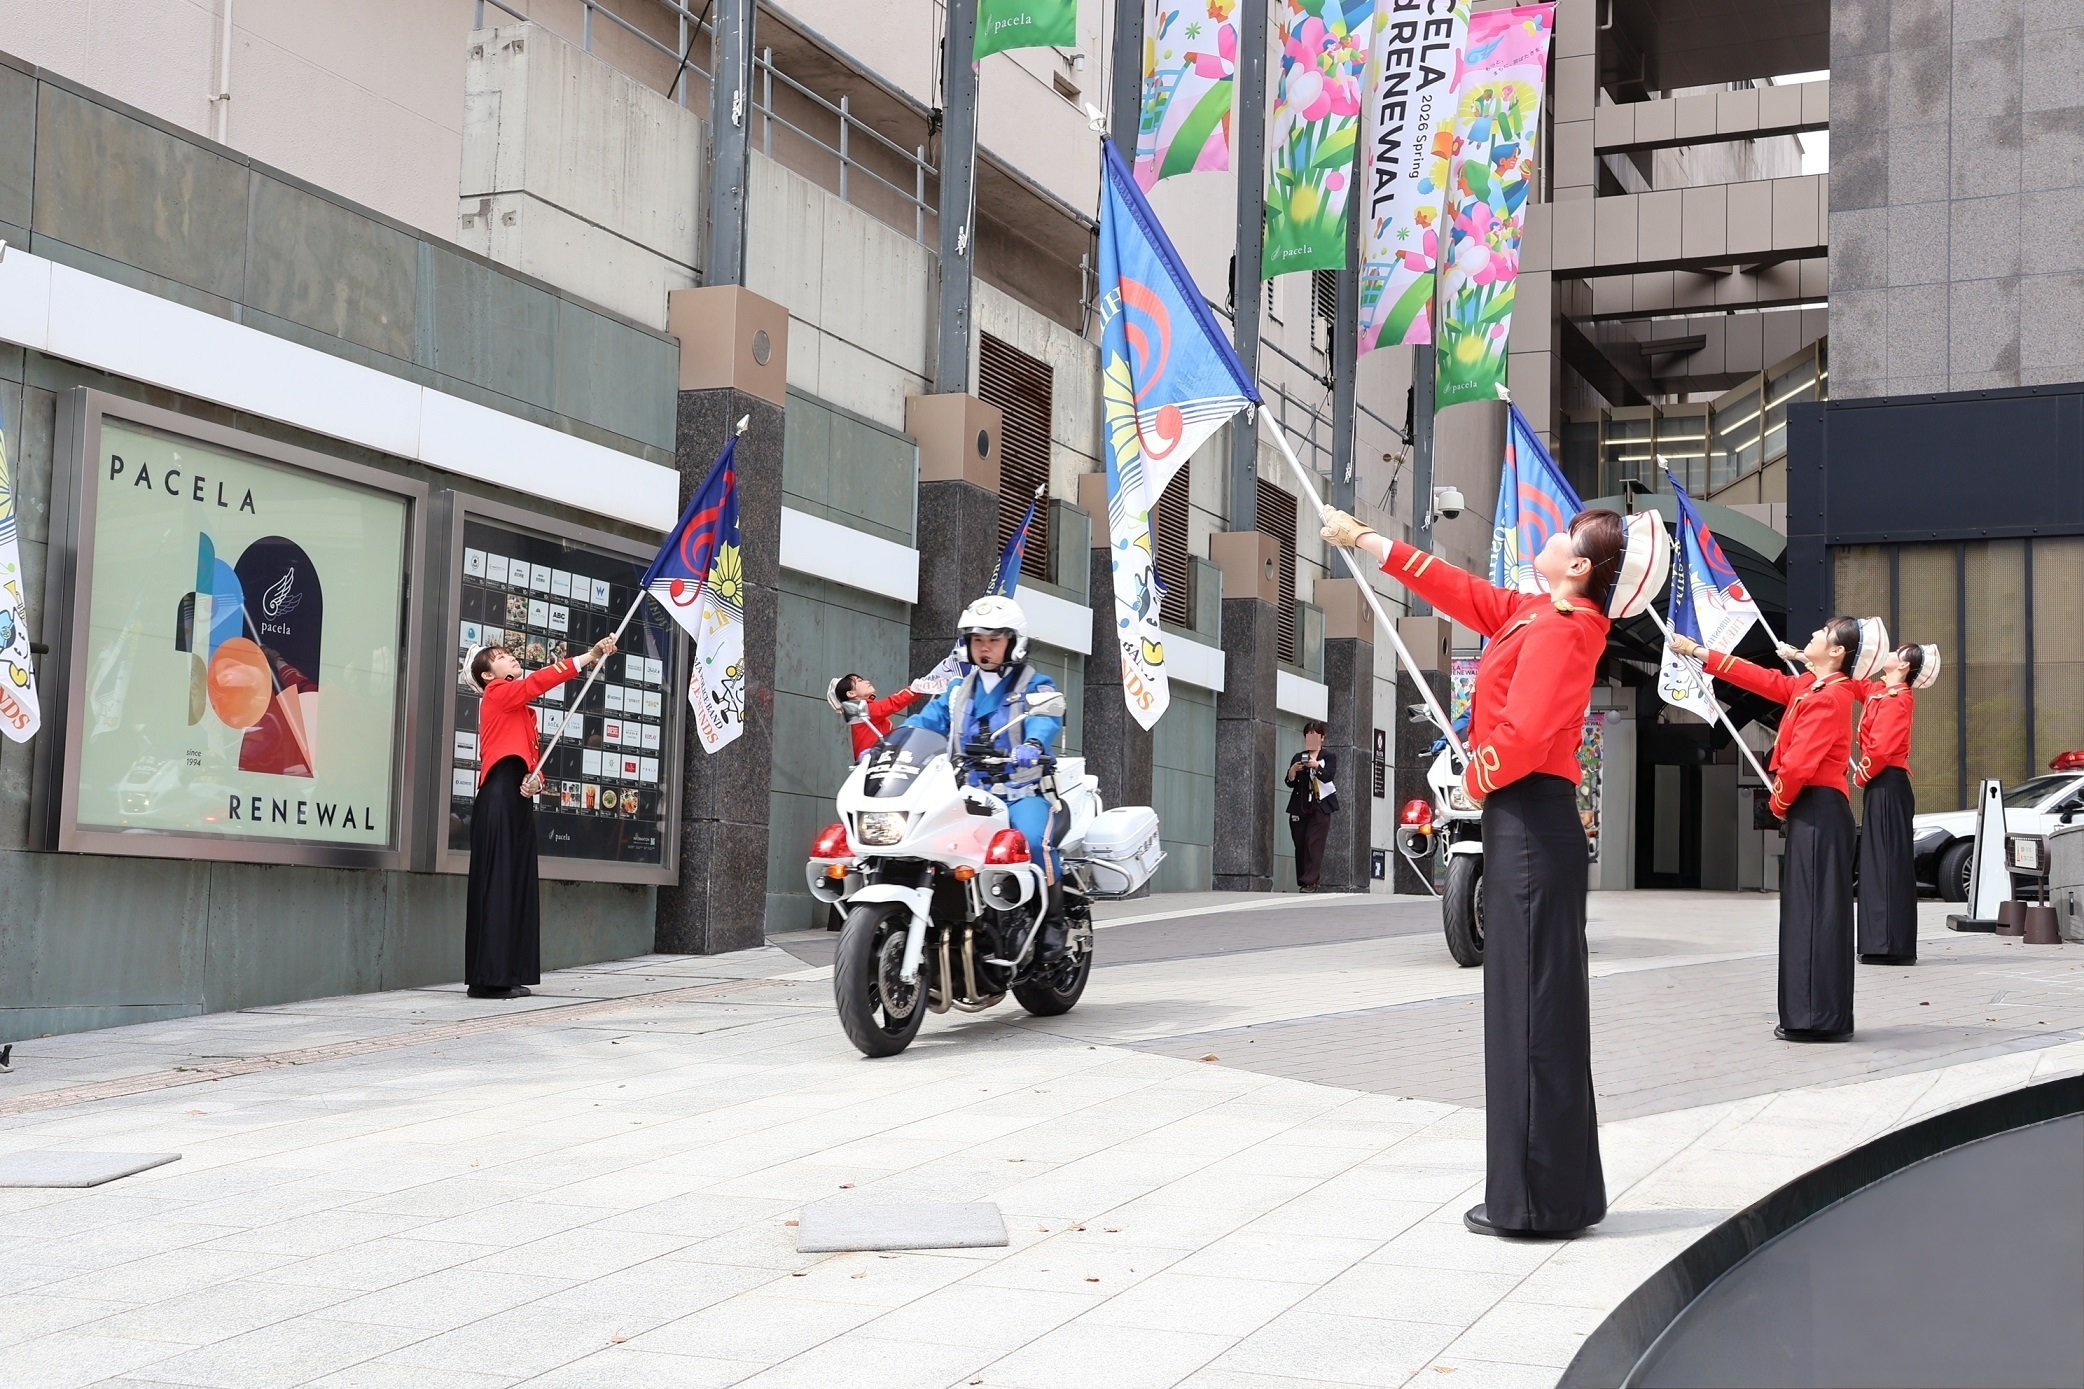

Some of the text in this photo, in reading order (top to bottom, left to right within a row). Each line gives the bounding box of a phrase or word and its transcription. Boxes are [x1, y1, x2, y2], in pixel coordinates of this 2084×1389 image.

[994, 13, 1032, 34] pacela
[1371, 21, 1418, 220] RENEWAL
[1417, 95, 1433, 131] 2026
[1408, 135, 1427, 179] Spring
[1282, 244, 1312, 260] pacela
[1452, 380, 1478, 394] pacela
[110, 454, 255, 515] PACELA
[552, 612, 566, 620] ABC
[261, 622, 291, 635] pacela
[706, 703, 724, 730] BAND
[186, 748, 202, 757] since
[186, 758, 201, 767] 1994
[229, 794, 375, 831] RENEWAL
[555, 833, 571, 842] pacela
